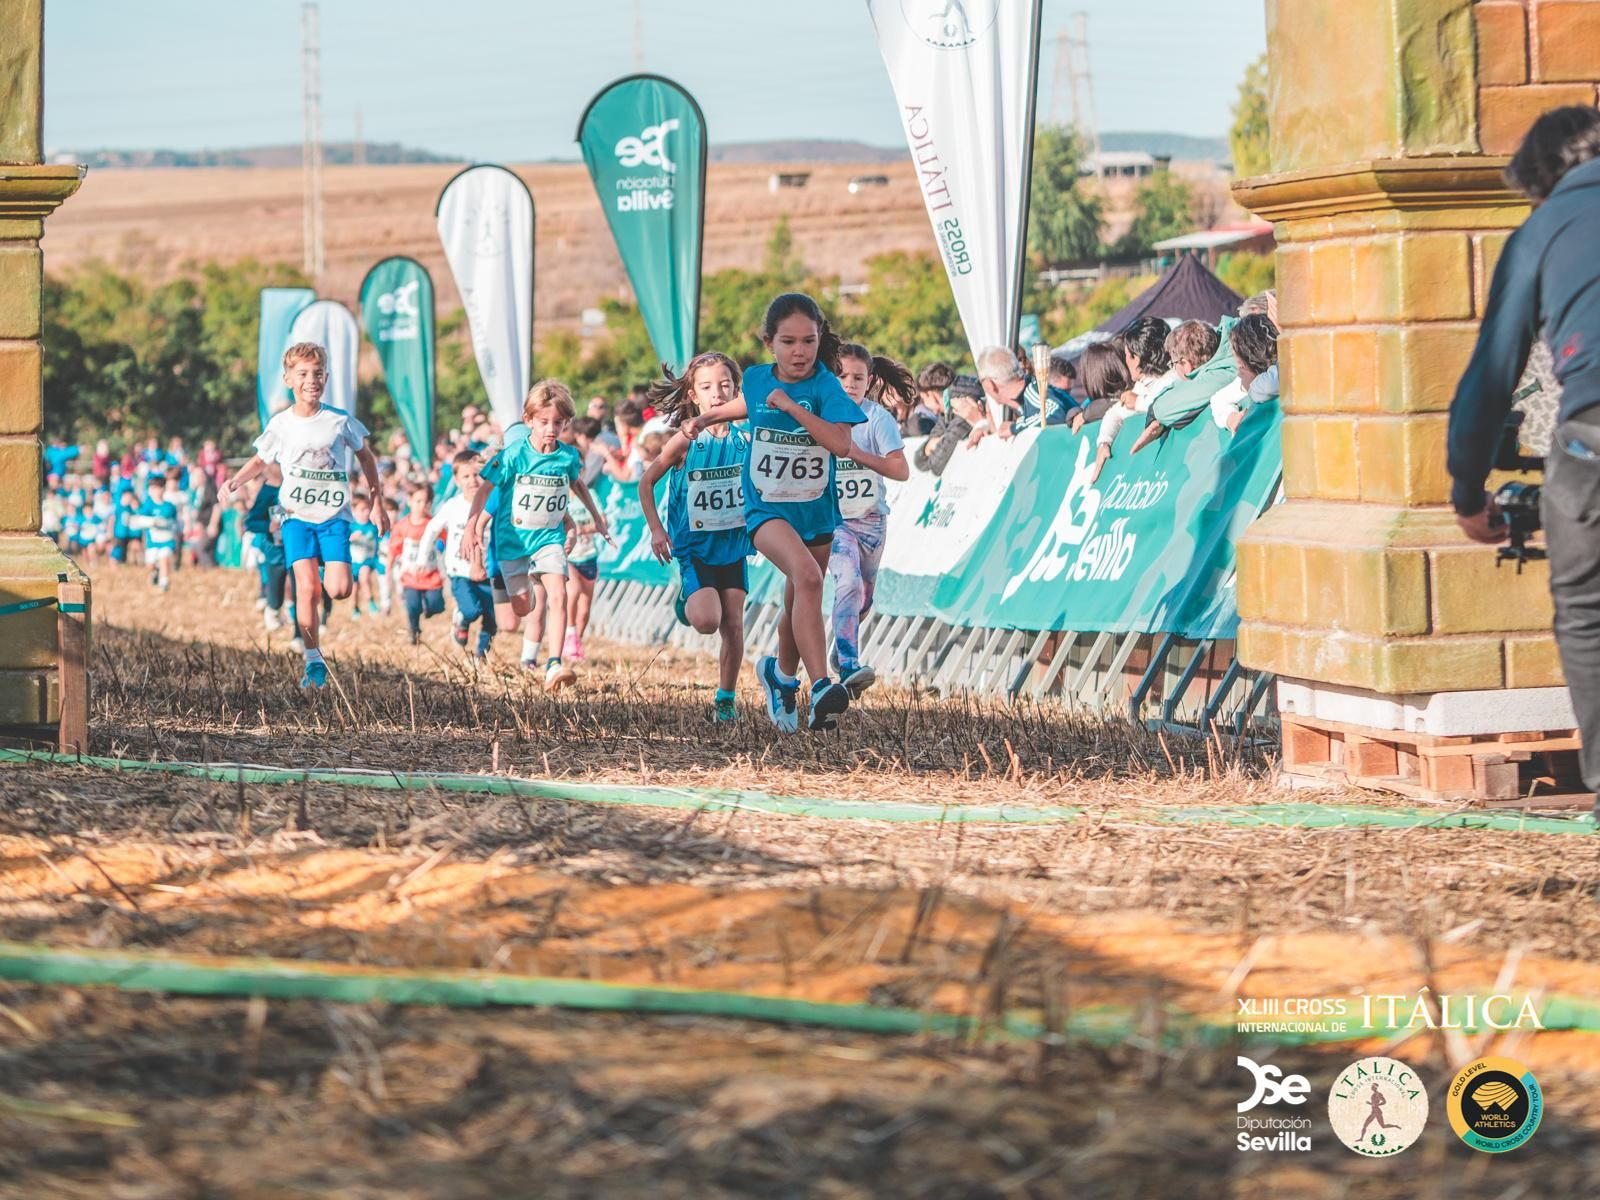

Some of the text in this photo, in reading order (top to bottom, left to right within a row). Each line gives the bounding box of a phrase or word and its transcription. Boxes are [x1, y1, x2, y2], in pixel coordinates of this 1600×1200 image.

[757, 454, 824, 480] 4763
[290, 486, 345, 508] 4649
[518, 493, 567, 512] 4760
